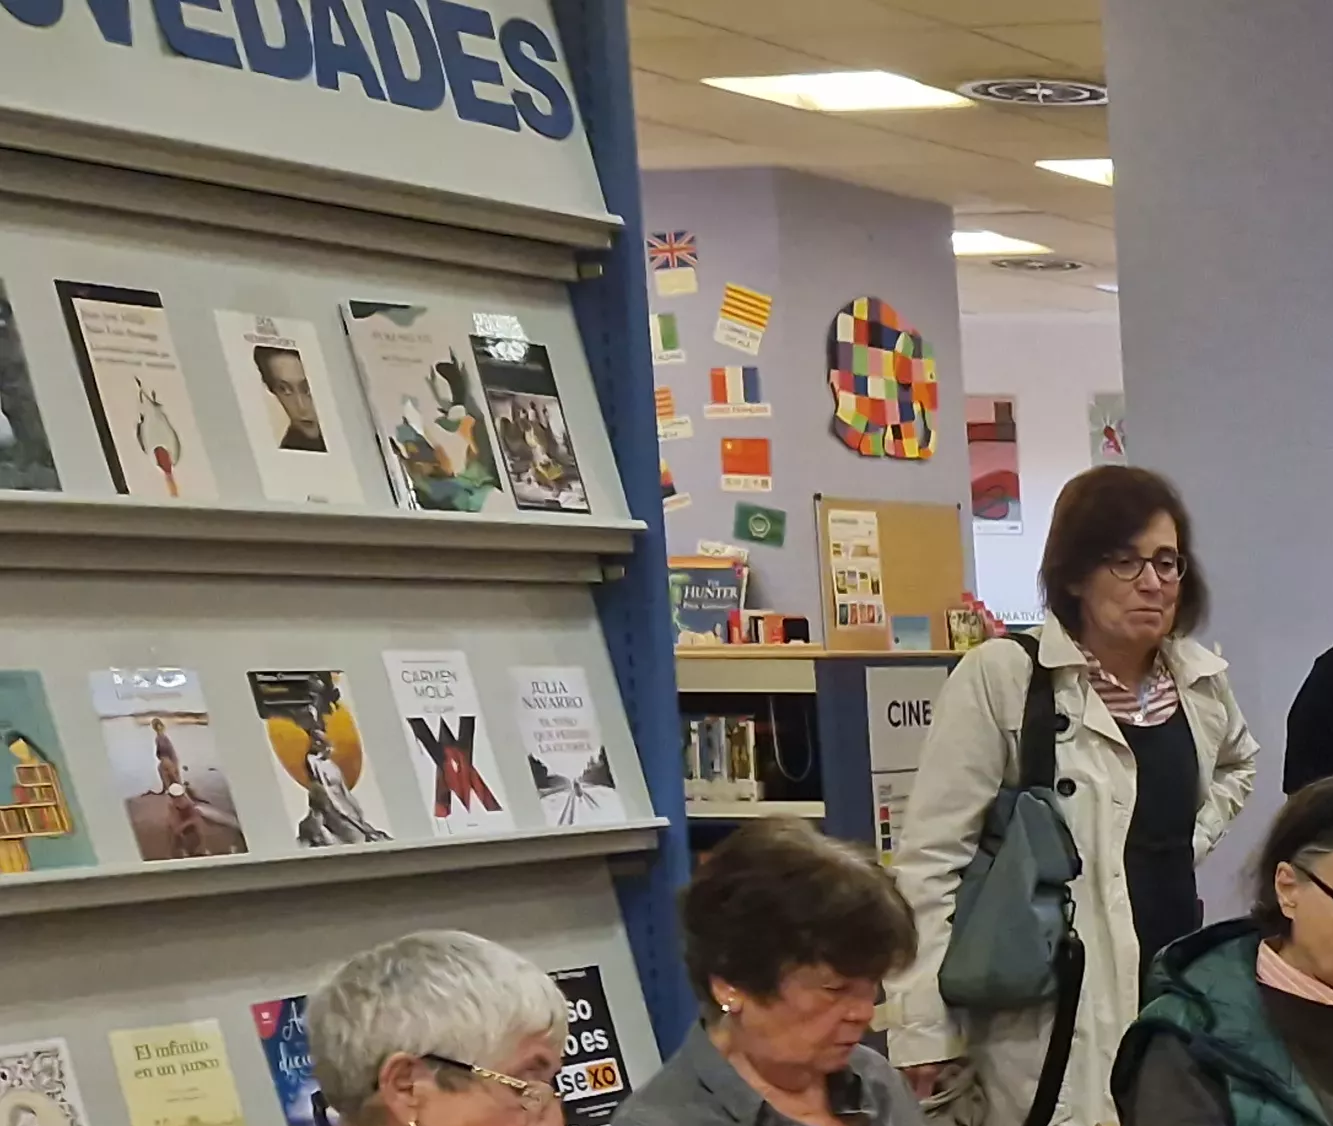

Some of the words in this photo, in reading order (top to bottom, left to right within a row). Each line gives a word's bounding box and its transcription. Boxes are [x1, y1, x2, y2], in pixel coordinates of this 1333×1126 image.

[683, 585, 738, 600] HUNTER
[401, 670, 458, 683] CARMEN
[413, 685, 455, 699] MOLA
[531, 681, 568, 695] JULIA
[521, 696, 584, 710] NAVARRO
[888, 700, 932, 727] CINE
[567, 998, 592, 1023] so
[580, 1028, 608, 1053] es
[134, 1043, 152, 1061] El
[156, 1040, 209, 1058] infinito
[134, 1066, 153, 1079] en
[156, 1064, 177, 1077] un
[561, 1065, 617, 1094] sexo
